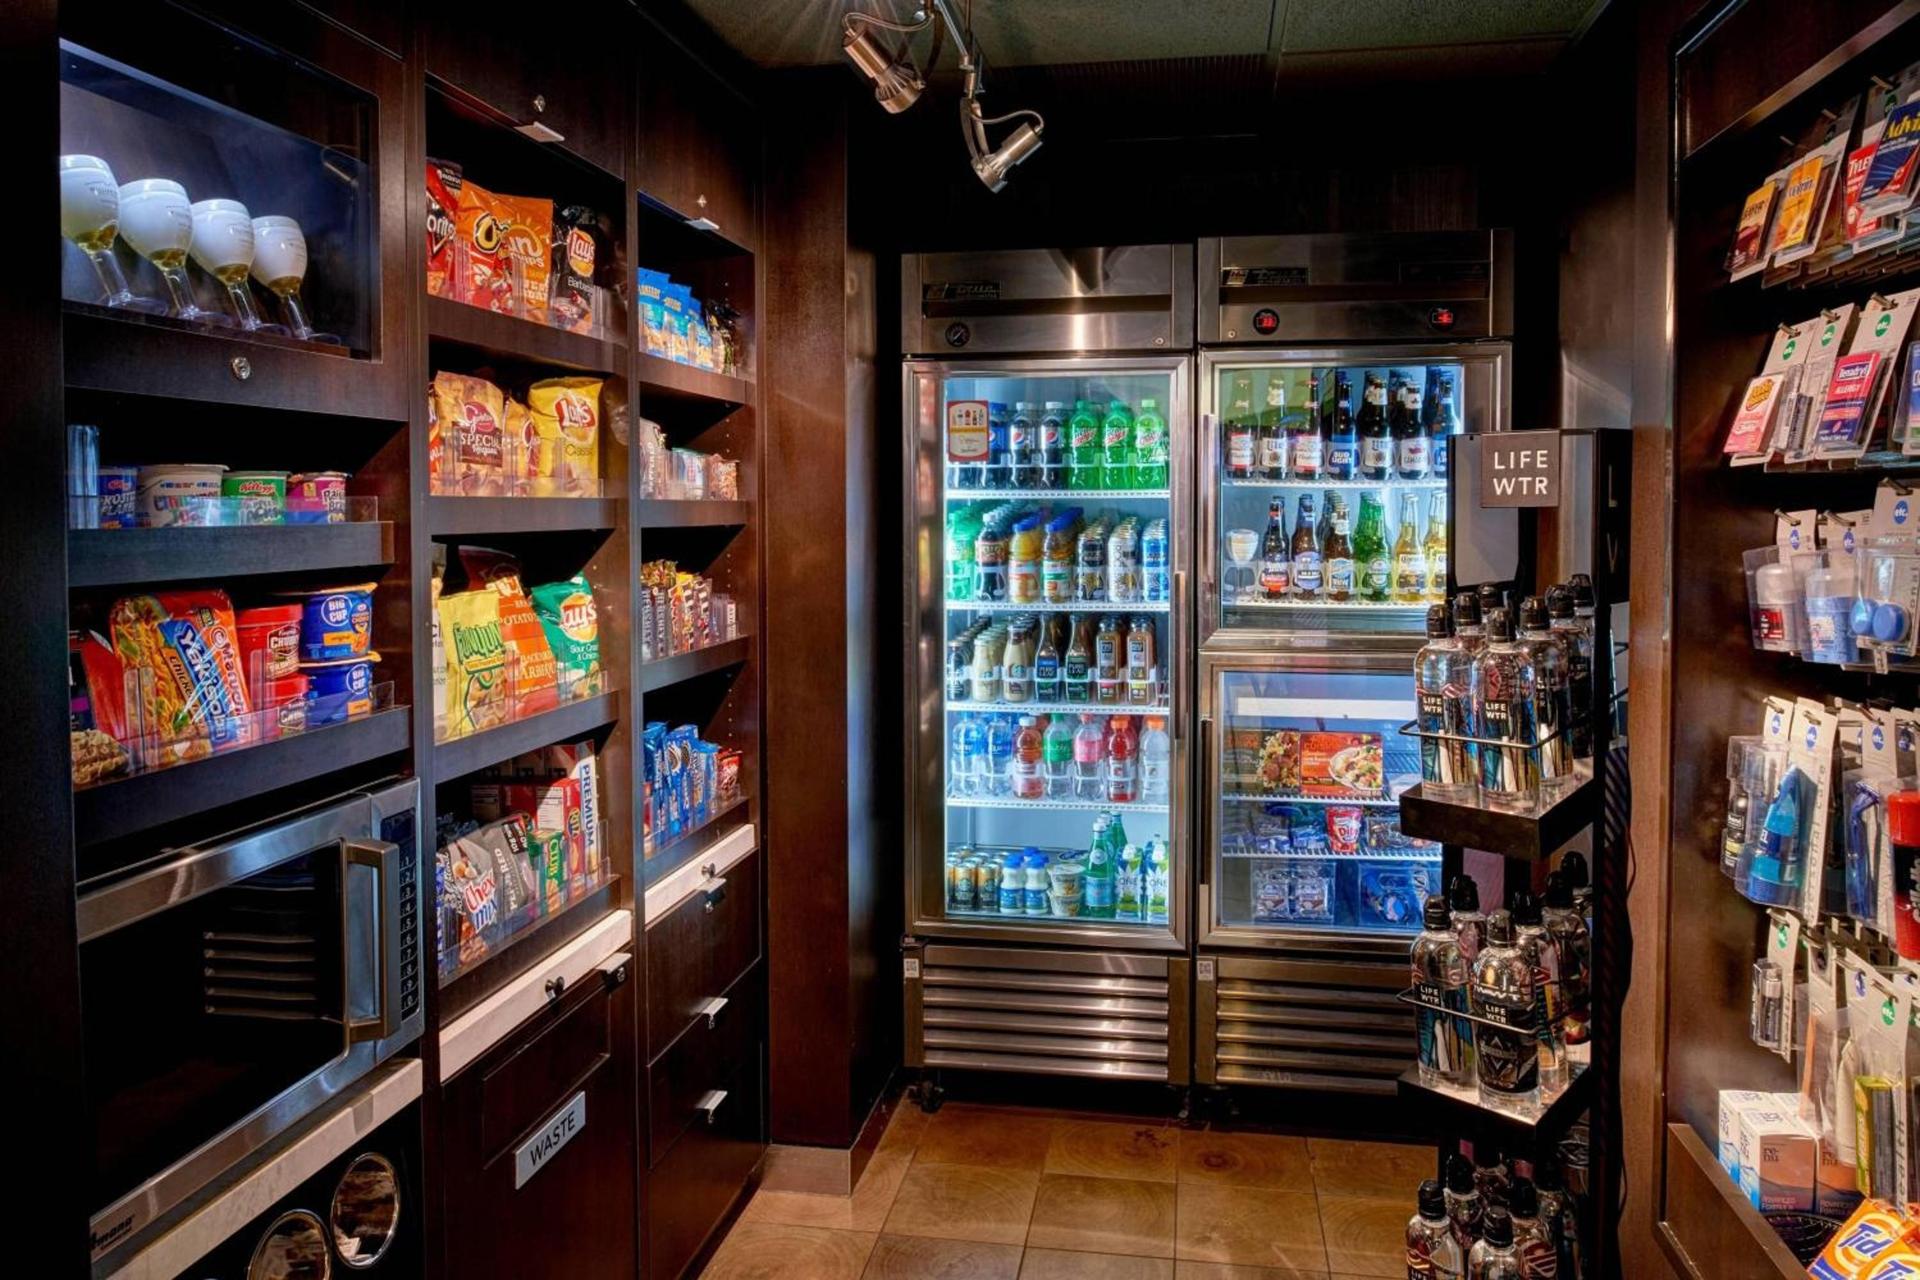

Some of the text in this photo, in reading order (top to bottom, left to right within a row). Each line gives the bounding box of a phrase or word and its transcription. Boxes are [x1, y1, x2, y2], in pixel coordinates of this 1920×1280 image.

[1494, 450, 1549, 470] LIFE
[1493, 476, 1549, 495] WTR
[1423, 697, 1442, 705] LIFE
[1485, 702, 1506, 711] LIFE
[1424, 705, 1442, 713] WTR
[1486, 711, 1507, 720] WTR
[582, 764, 595, 846] PREMIUM
[465, 869, 497, 912] Chex
[1420, 985, 1439, 996] LIFE
[1485, 1004, 1507, 1016] LIFE
[530, 1111, 575, 1166] WASTE
[1838, 1222, 1894, 1259] Tid
